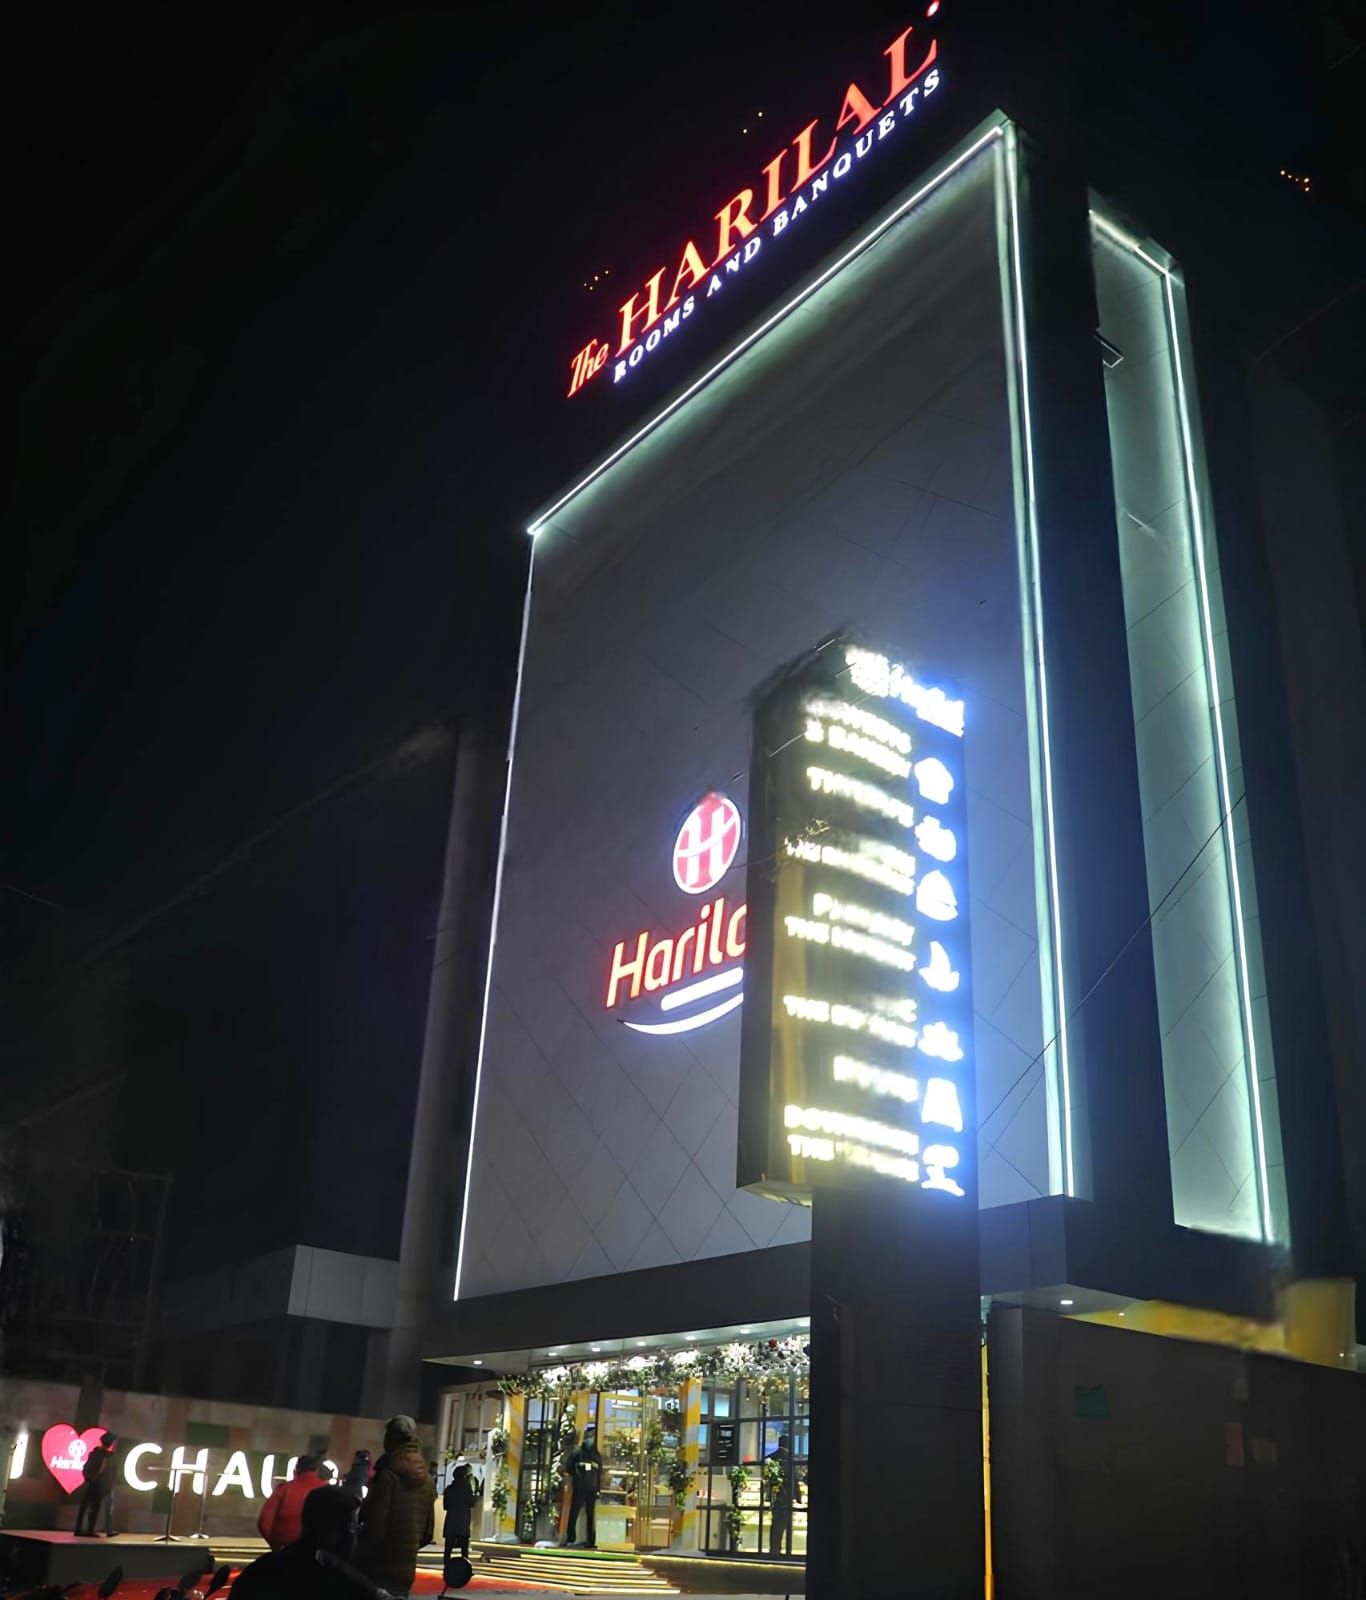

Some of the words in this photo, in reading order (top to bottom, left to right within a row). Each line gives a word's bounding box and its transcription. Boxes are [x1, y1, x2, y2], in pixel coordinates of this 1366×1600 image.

[566, 337, 610, 399] The
[614, 26, 938, 358] HARILAL
[613, 299, 695, 382] ROOMS
[706, 235, 762, 297] AND
[773, 68, 941, 236] BANQUETS
